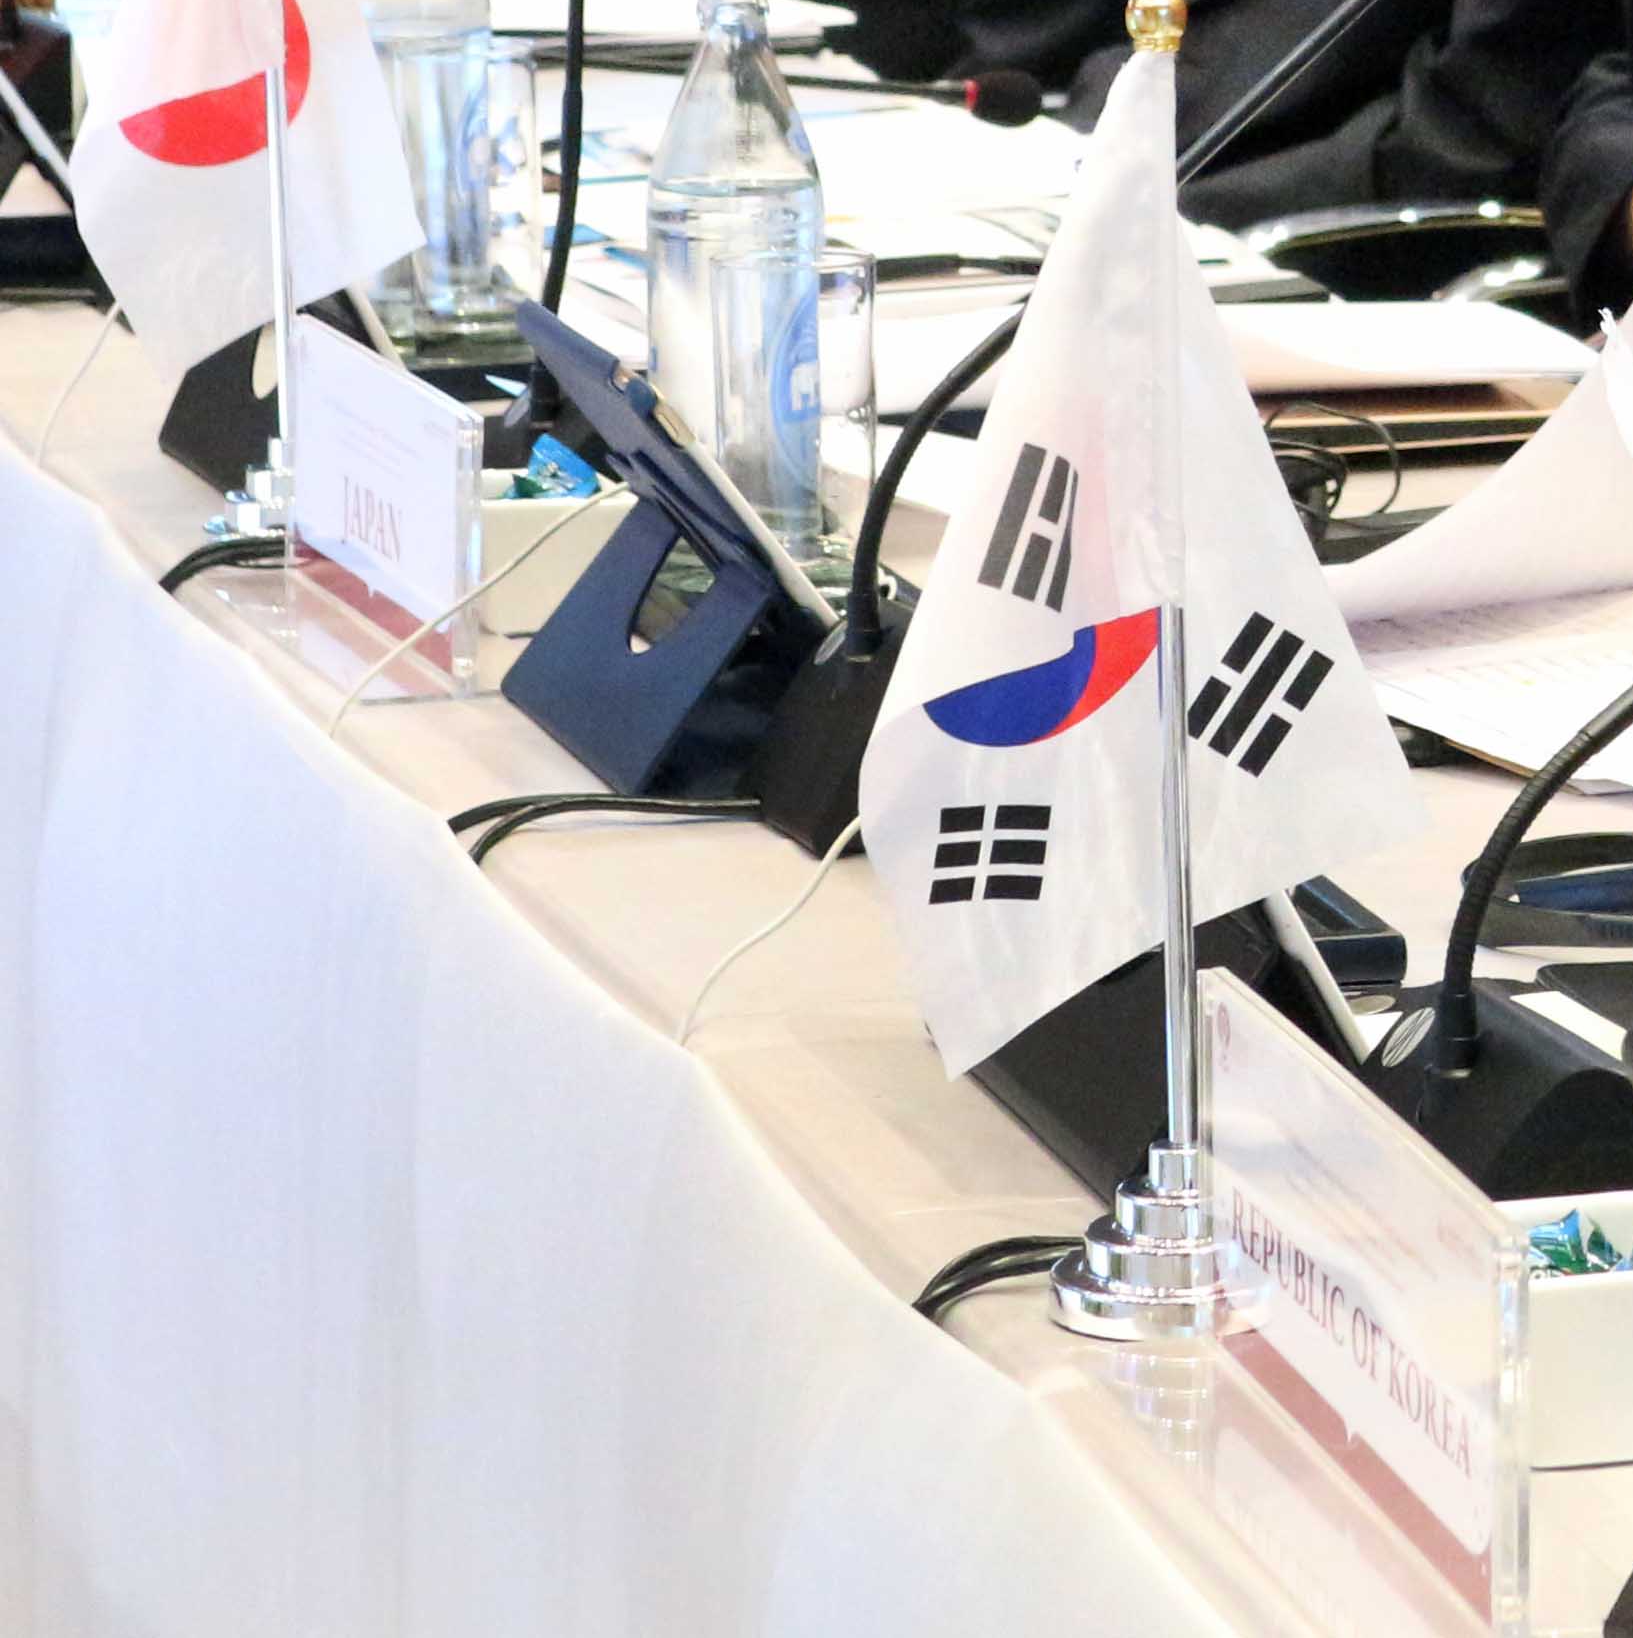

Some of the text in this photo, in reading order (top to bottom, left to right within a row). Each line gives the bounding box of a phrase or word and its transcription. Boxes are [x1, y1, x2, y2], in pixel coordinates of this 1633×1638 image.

[340, 474, 404, 563] JAPAN
[1231, 1185, 1346, 1347] REPUBLIC
[1351, 1306, 1383, 1382] OF
[1385, 1332, 1473, 1480] KOREA
